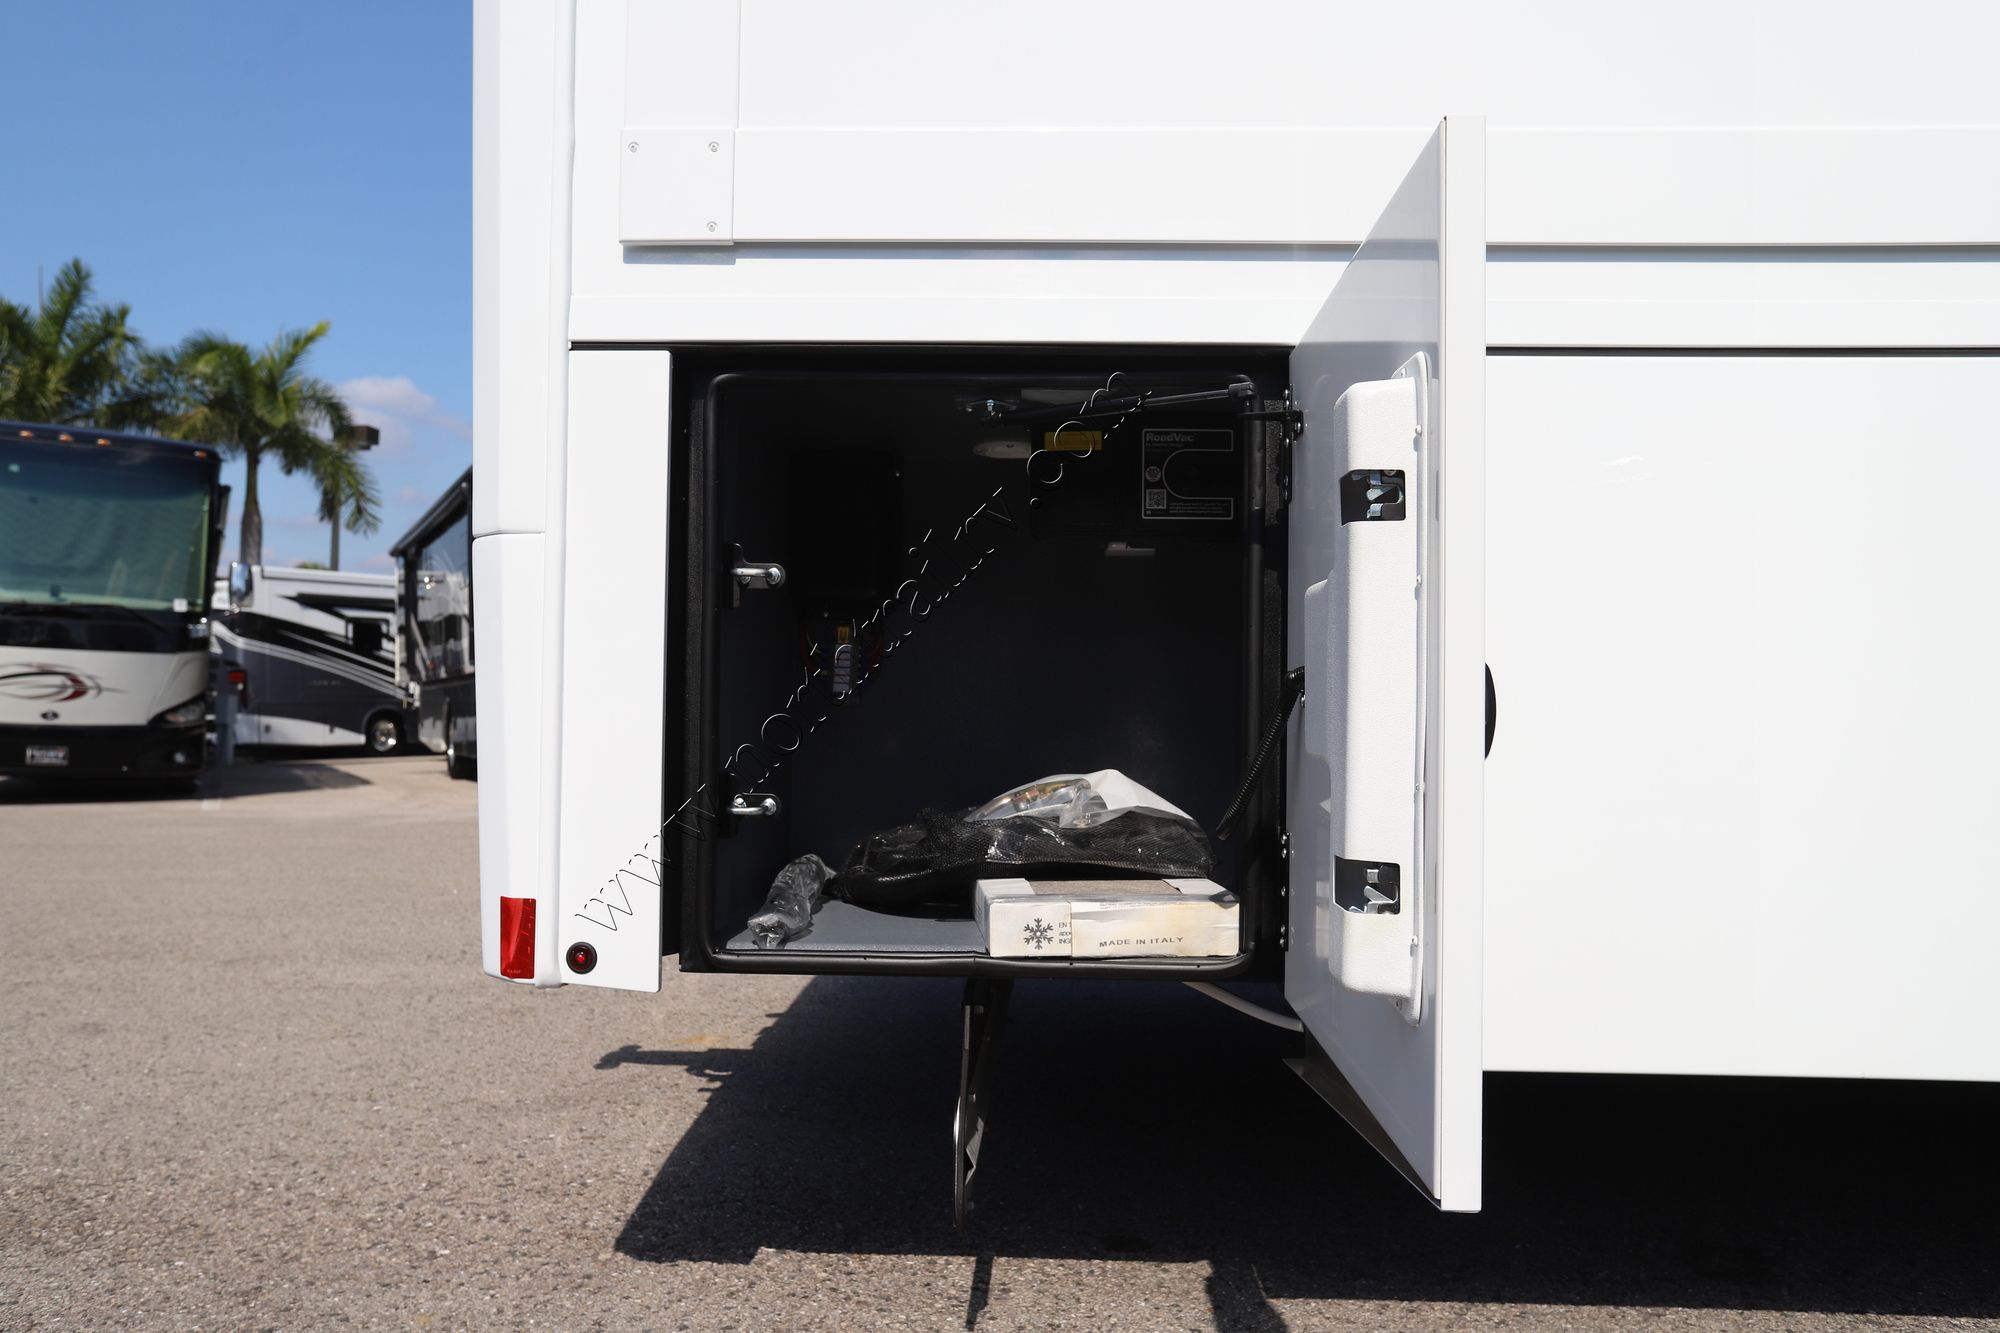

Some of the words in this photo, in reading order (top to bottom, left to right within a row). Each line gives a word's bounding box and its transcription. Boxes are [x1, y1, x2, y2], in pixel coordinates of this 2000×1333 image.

[1145, 432, 1195, 442] RoadVac
[1099, 938, 1131, 948] MADE
[1150, 936, 1184, 945] ITALY
